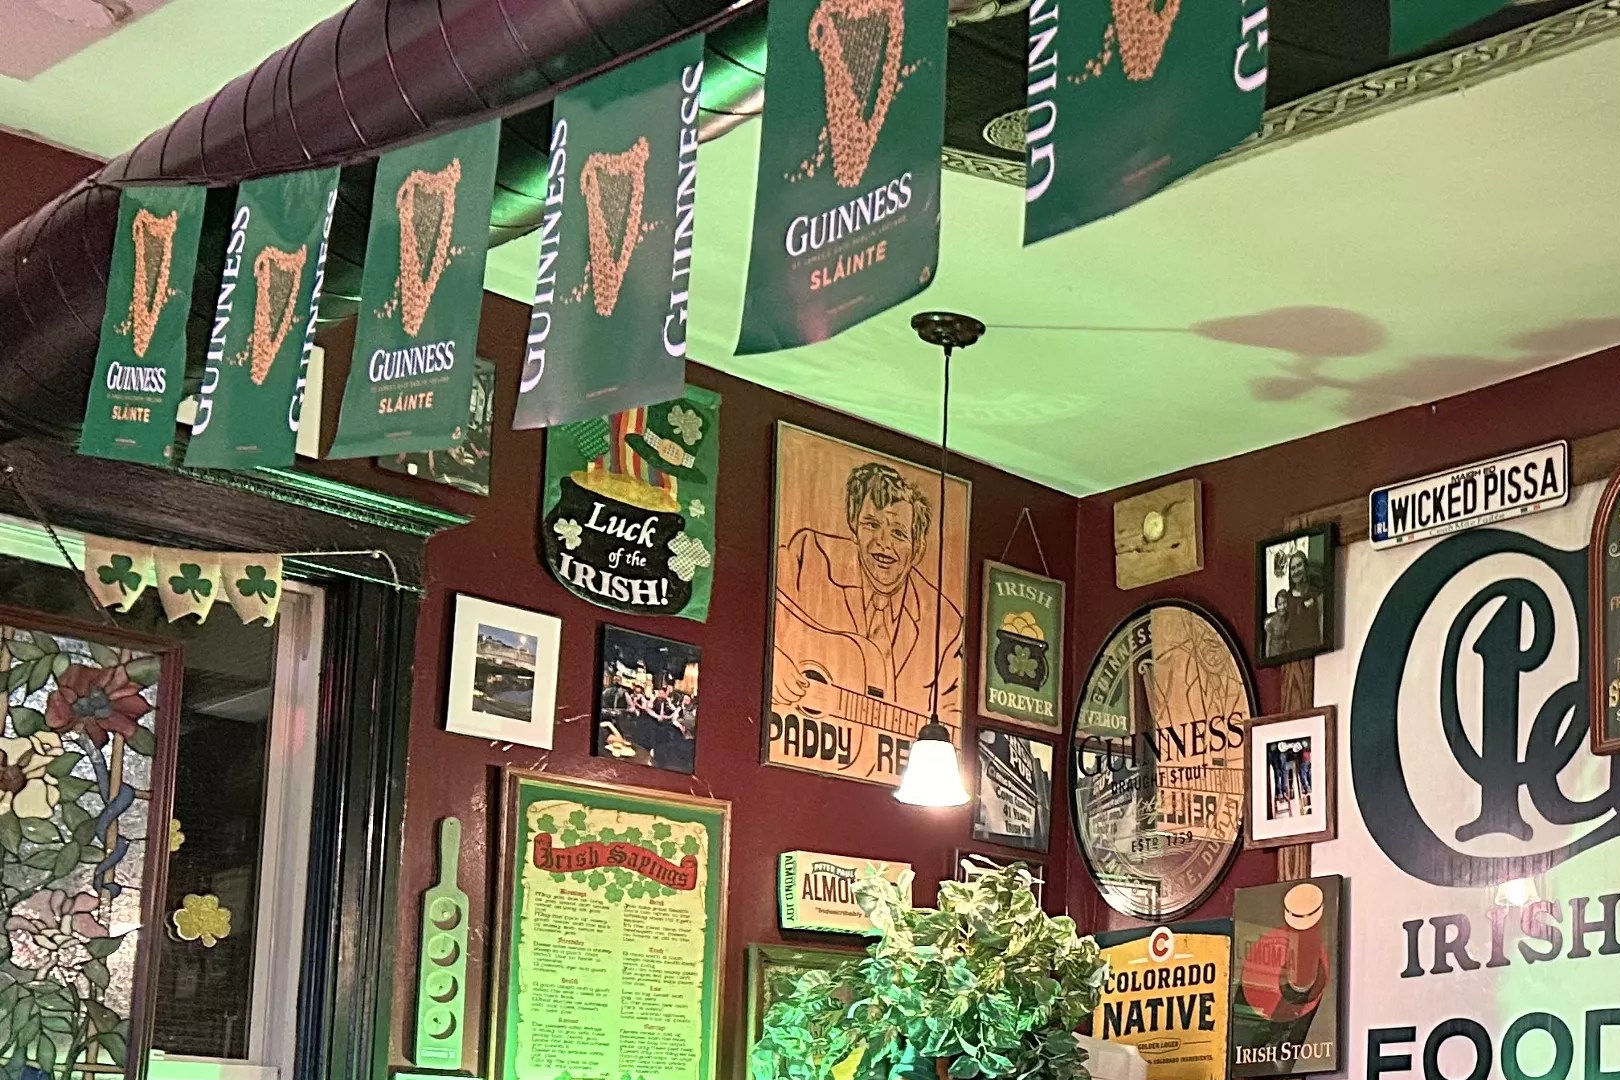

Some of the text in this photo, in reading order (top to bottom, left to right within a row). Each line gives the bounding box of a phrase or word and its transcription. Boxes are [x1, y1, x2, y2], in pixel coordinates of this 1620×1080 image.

[663, 59, 705, 358] GUINNESS
[785, 171, 912, 257] GUINNESS
[520, 118, 568, 394] GUINNESS
[191, 205, 251, 436] GUINNESS
[107, 361, 166, 394] GUINNESS
[369, 341, 456, 383] GUINNESS
[1391, 457, 1558, 534] WICKED PISSA
[584, 501, 659, 548] Luck
[608, 547, 648, 569] of the
[558, 551, 669, 606] IRISH!
[995, 580, 1054, 611] IRISH
[988, 687, 1055, 719] FOREVER
[769, 710, 853, 767] PADDY
[1078, 711, 1245, 777] GUINNESS
[1111, 763, 1209, 795] DRAUGHT STOUT
[540, 845, 599, 869] Irish
[1166, 830, 1194, 847] 1759
[801, 873, 855, 905] ALMO
[1152, 932, 1169, 957] C
[1103, 962, 1216, 995] COLORADO
[1102, 992, 1216, 1041] NATIVE
[1235, 1041, 1335, 1065] IRISH STOUT
